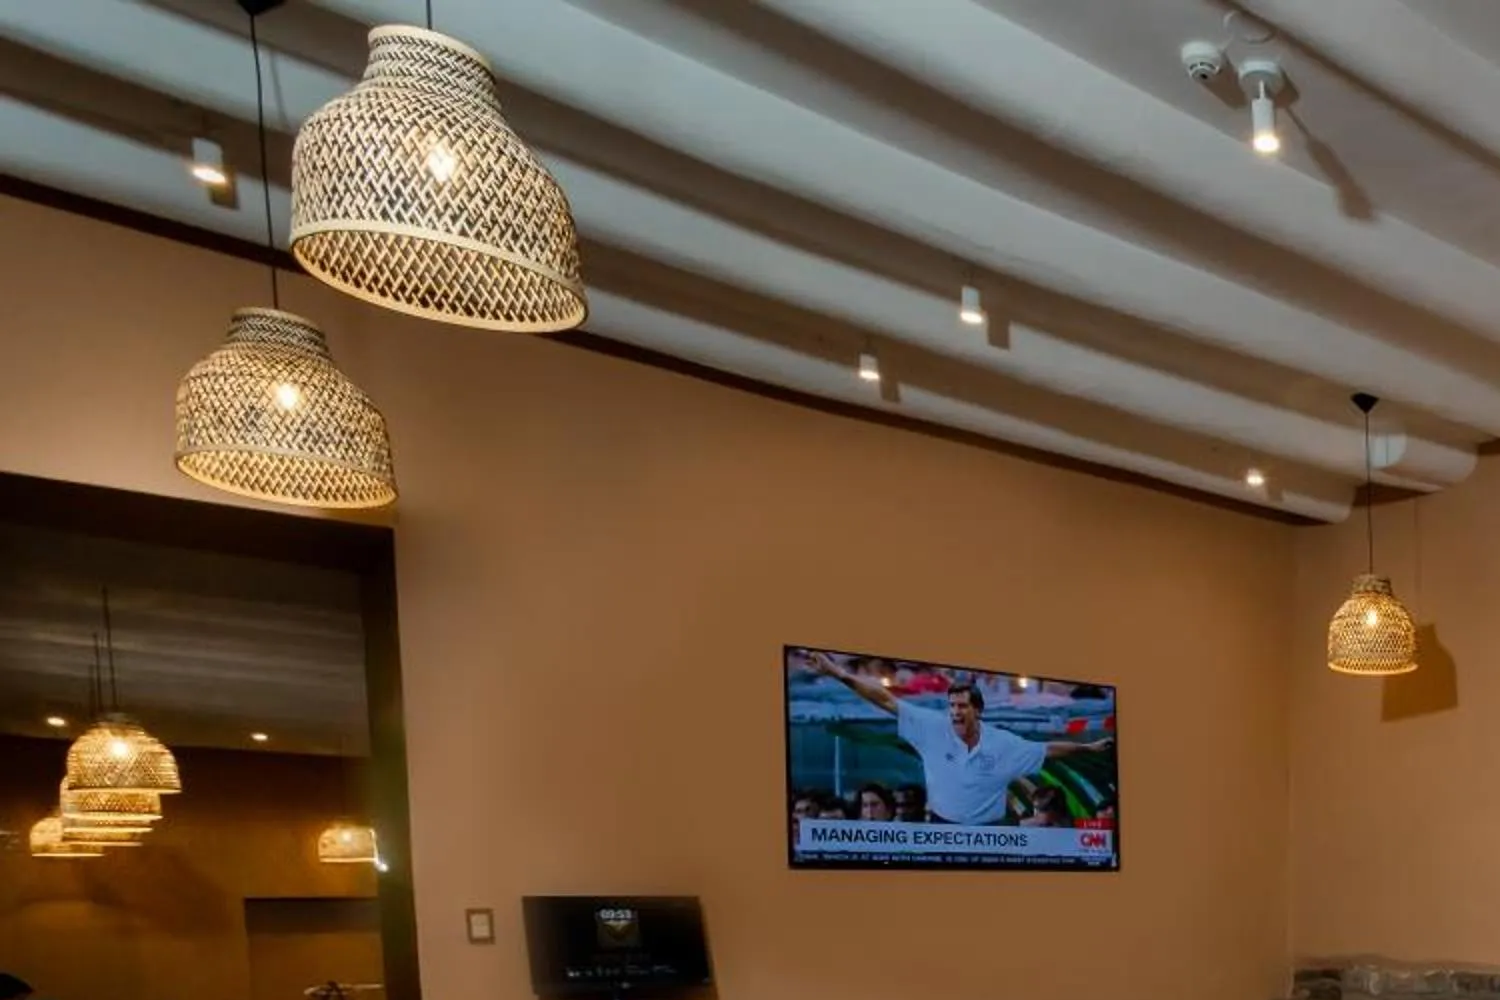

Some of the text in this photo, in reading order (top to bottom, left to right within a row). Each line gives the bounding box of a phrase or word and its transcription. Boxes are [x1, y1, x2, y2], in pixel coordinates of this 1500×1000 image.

[811, 827, 1028, 847] MANAGING EXPECTATIONS
[1080, 832, 1106, 848] CNN
